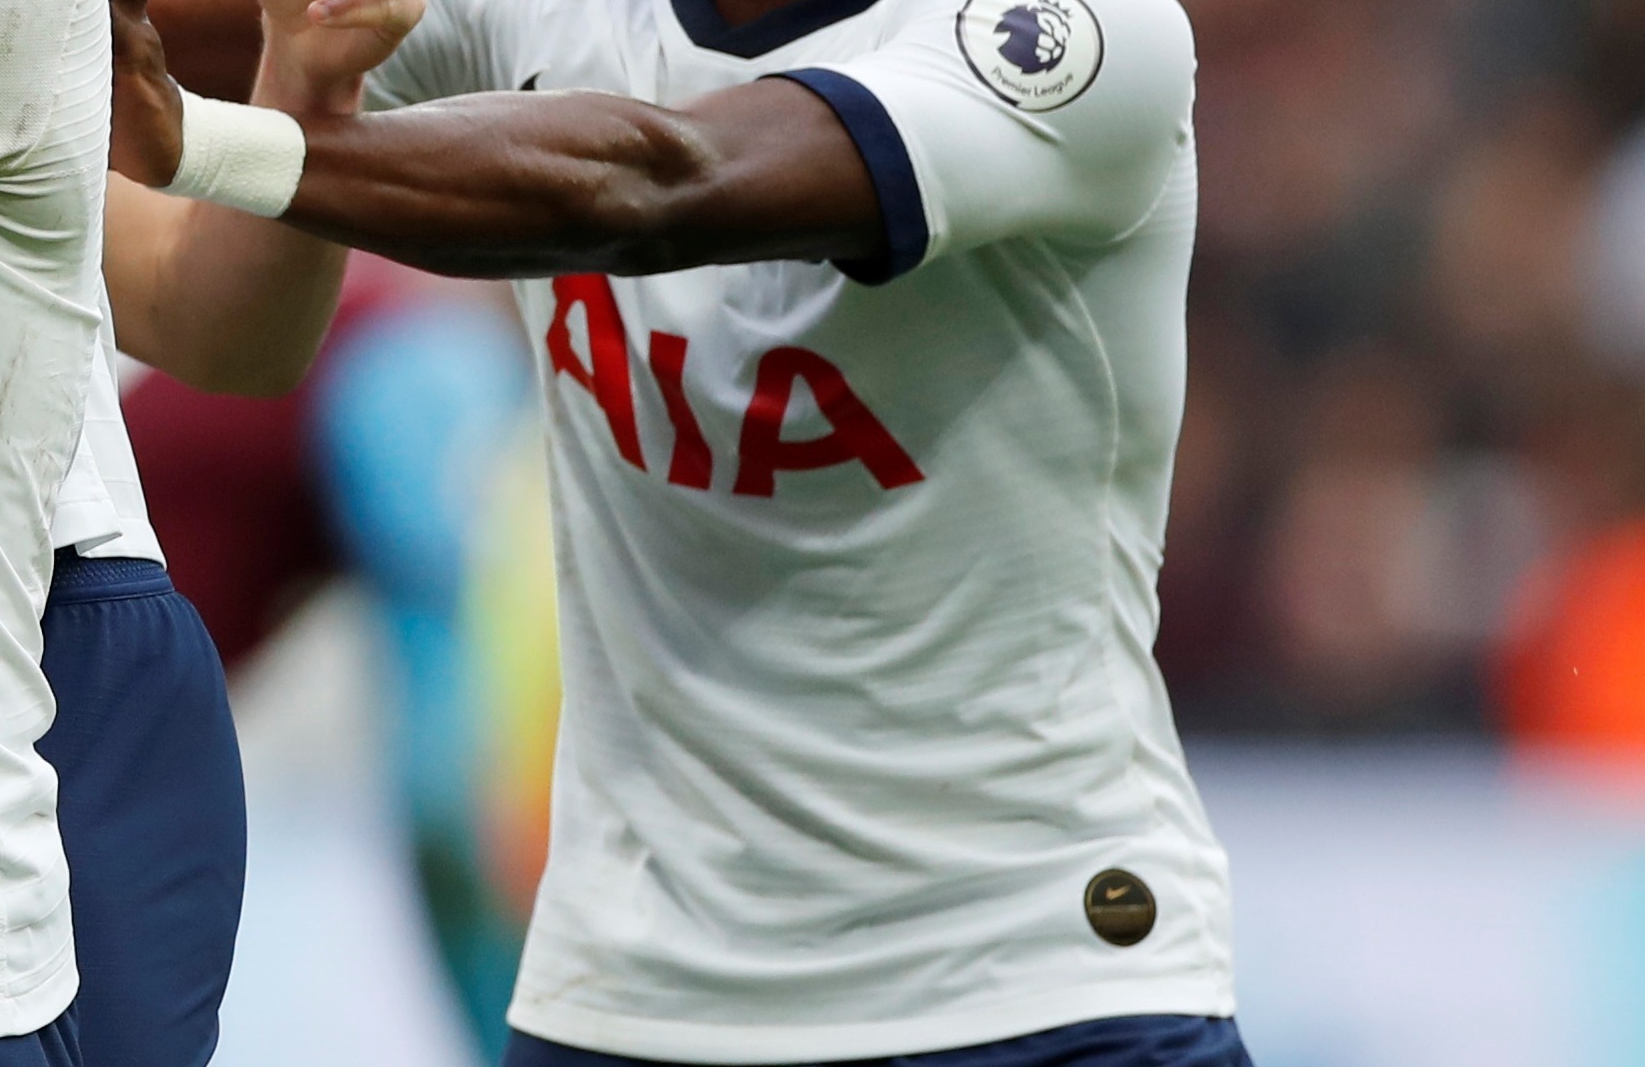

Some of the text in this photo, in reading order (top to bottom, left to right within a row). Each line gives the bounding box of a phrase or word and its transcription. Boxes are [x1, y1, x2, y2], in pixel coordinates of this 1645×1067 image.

[991, 65, 1074, 97] Premier League
[546, 272, 927, 498] AIA
